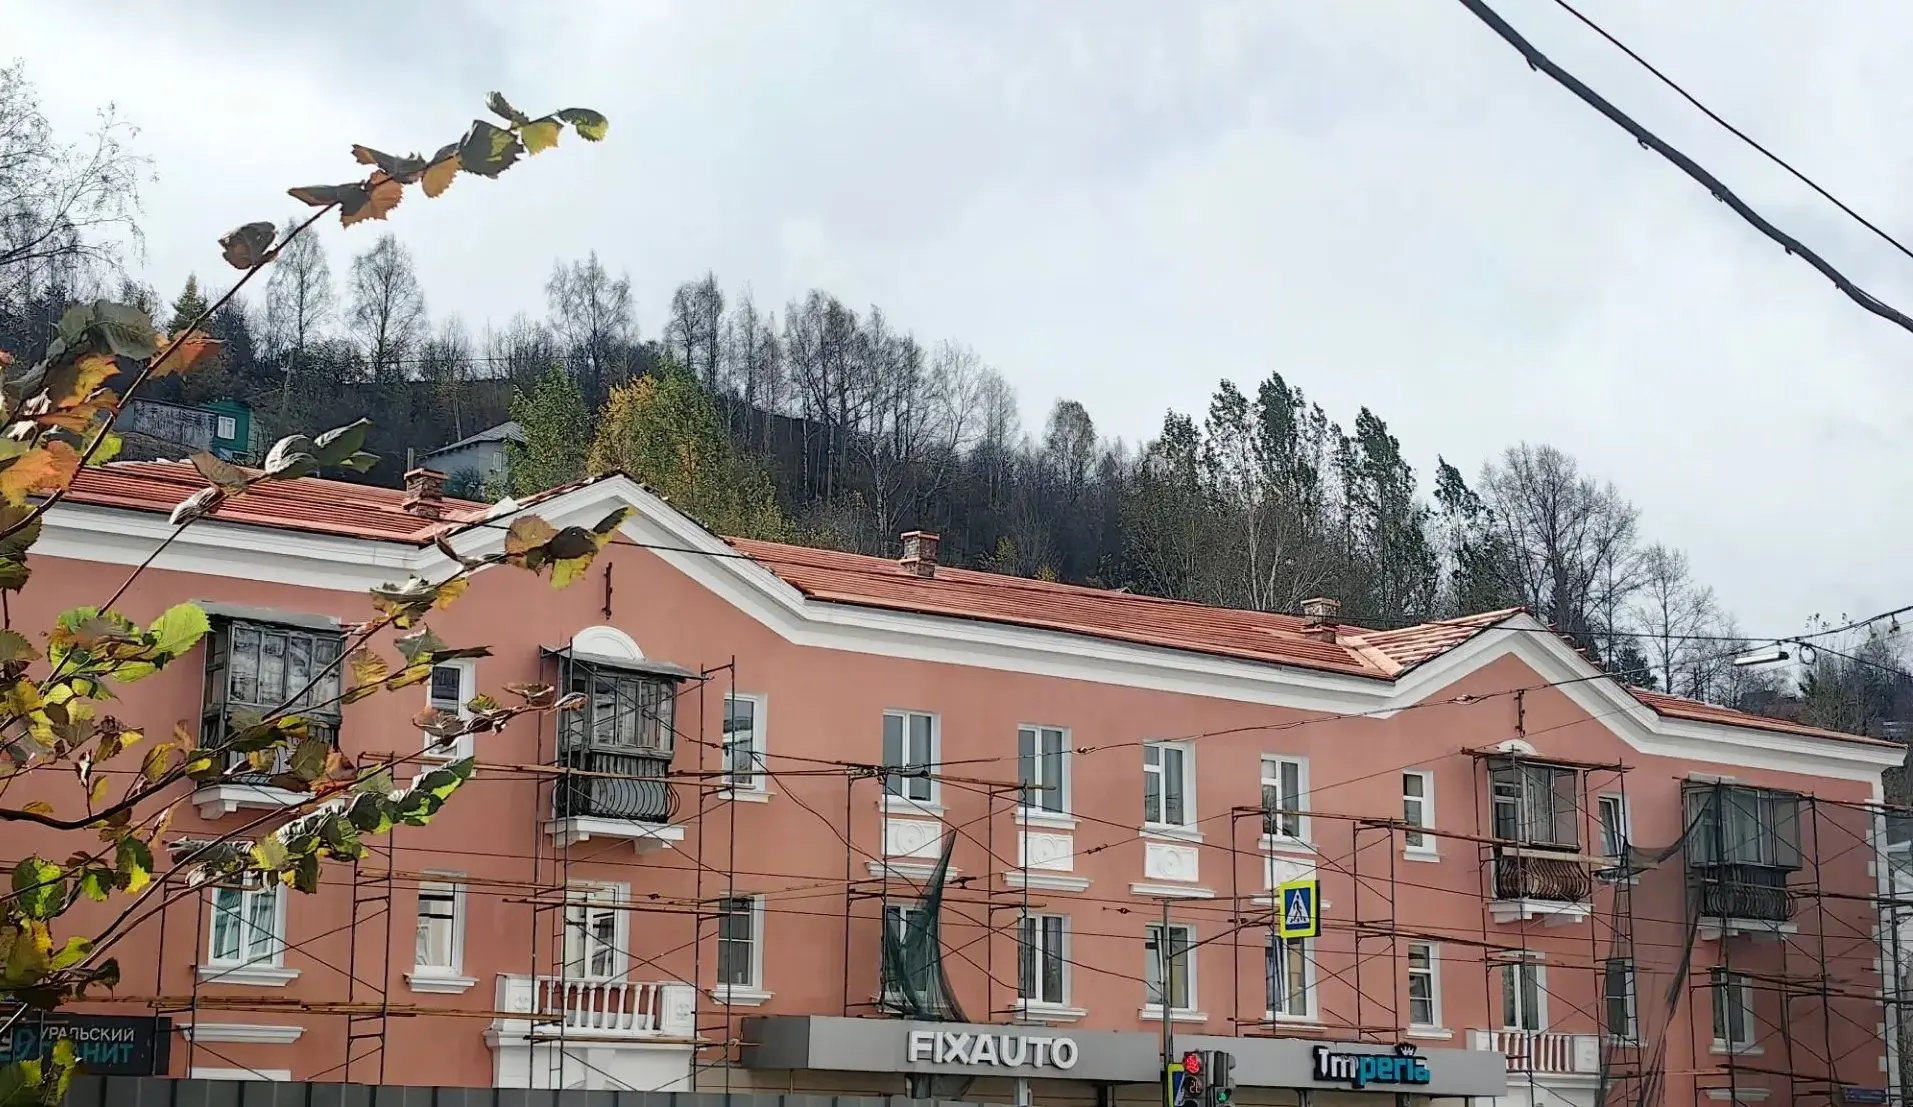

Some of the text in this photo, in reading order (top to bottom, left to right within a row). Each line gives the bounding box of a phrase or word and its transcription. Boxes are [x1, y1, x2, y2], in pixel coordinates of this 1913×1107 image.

[41, 1026, 135, 1042] УРАЛЬСКИЙ
[42, 1041, 134, 1064] НИТ
[908, 1030, 1079, 1070] FIXAUTO
